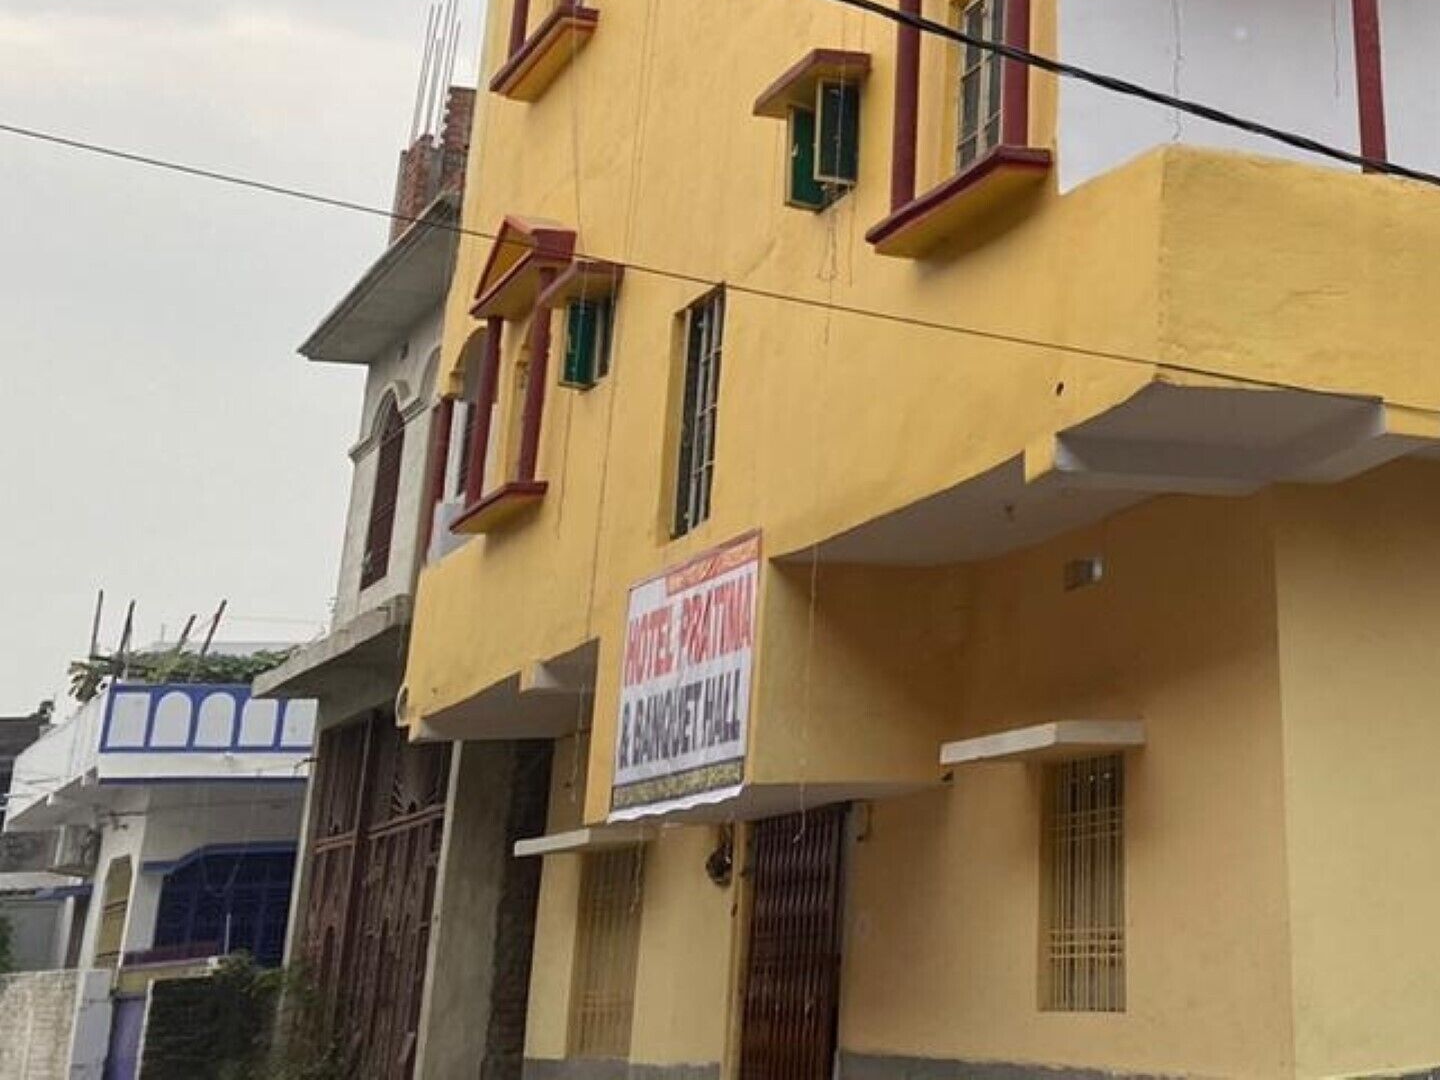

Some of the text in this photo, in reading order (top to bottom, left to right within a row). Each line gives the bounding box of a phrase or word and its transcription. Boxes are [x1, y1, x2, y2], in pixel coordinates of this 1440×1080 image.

[624, 573, 752, 687] HOTEL PRATIMA
[632, 681, 702, 766] BANQUET
[703, 667, 740, 748] HALL
